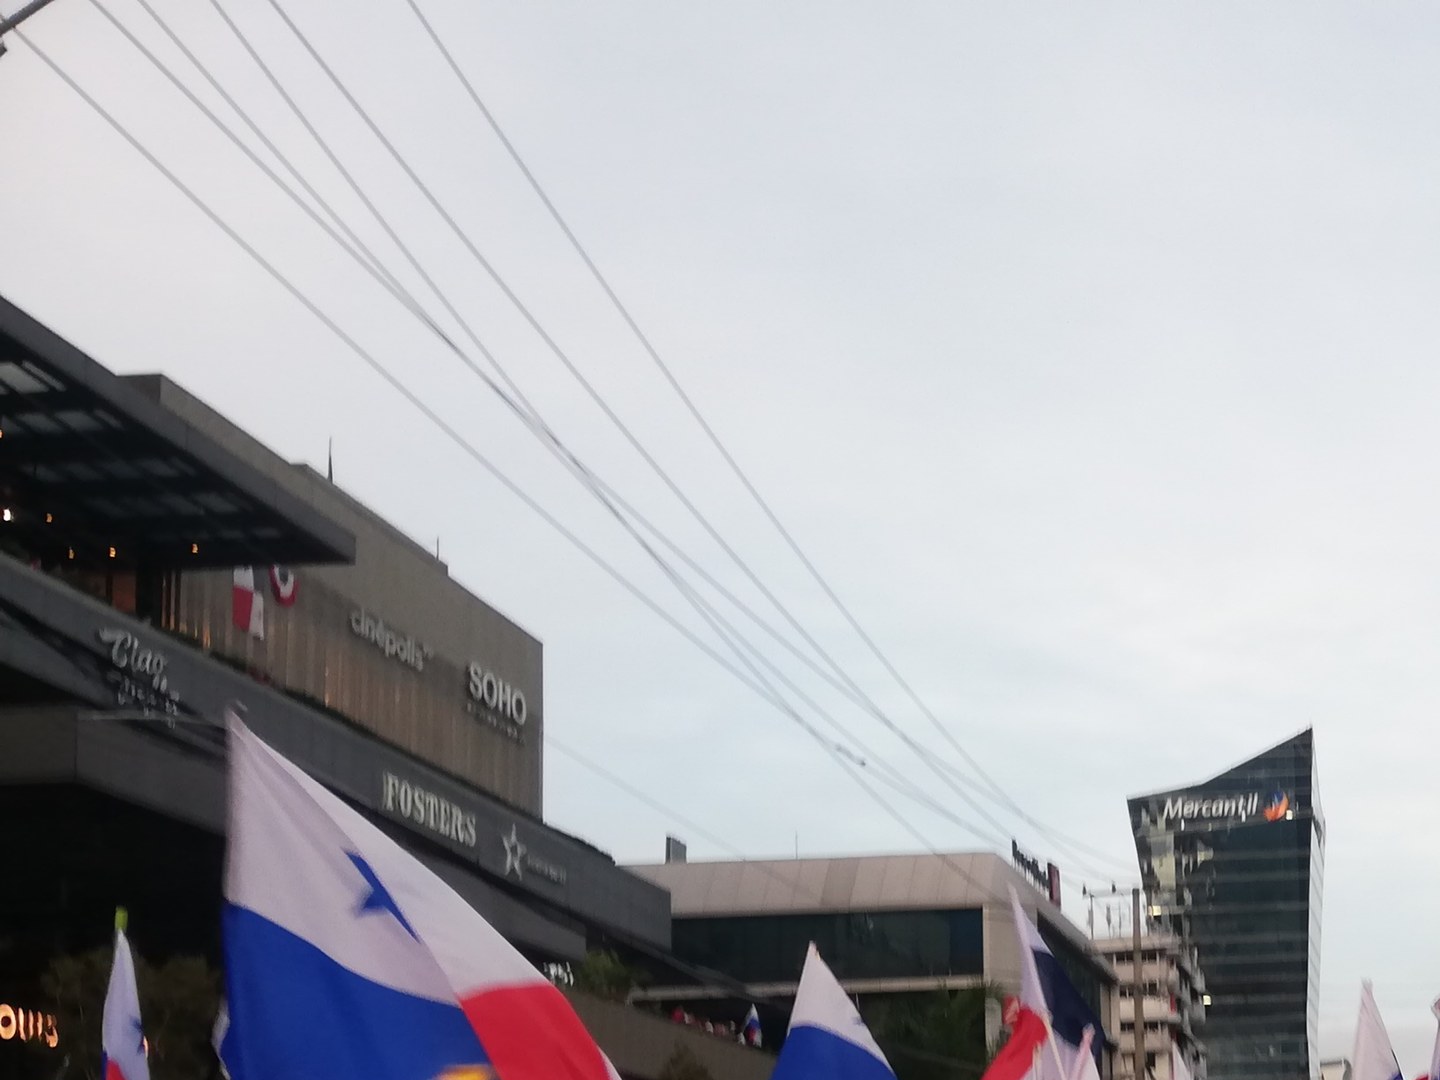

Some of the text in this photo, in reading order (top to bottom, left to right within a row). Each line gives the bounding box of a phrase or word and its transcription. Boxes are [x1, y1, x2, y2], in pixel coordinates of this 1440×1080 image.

[469, 660, 527, 726] SOHO
[382, 770, 476, 847] FOSTERS
[1164, 792, 1259, 819] Mercantil
